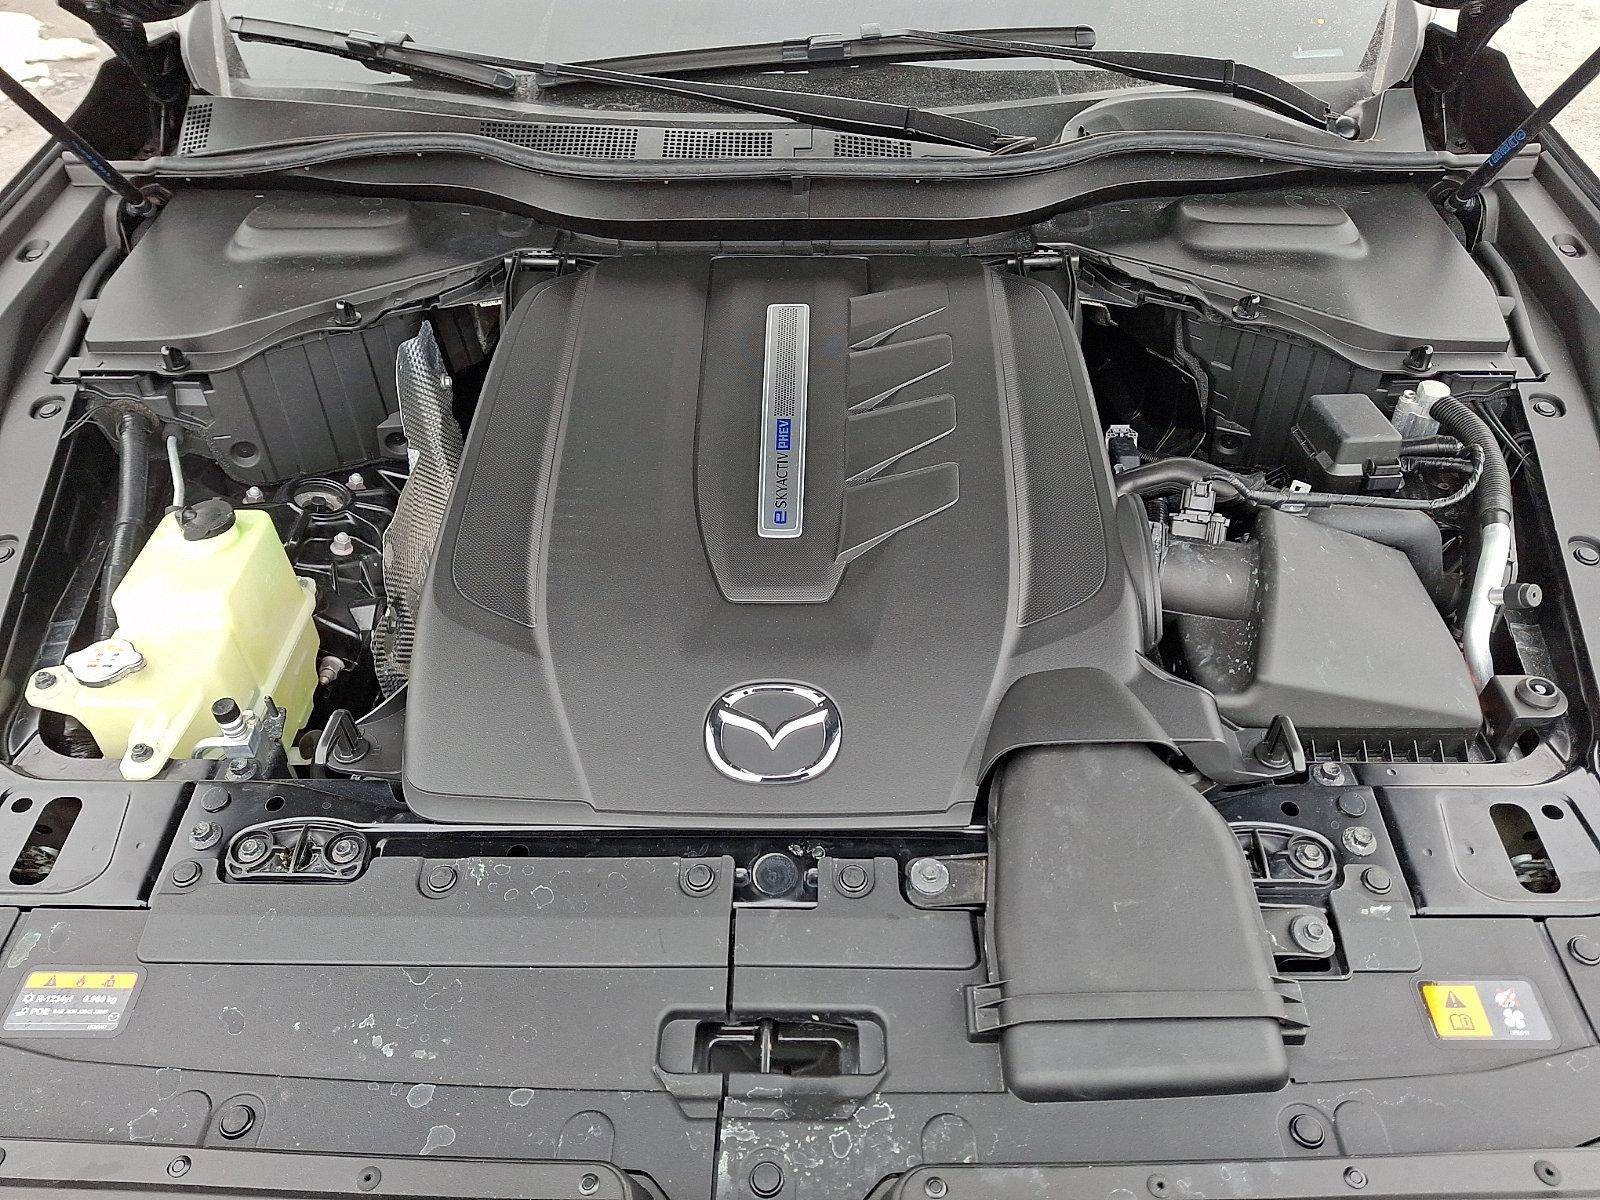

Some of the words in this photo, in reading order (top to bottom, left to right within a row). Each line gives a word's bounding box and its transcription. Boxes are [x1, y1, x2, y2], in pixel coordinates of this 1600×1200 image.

[777, 419, 790, 450] PHEV
[775, 452, 789, 509] SKYACTIV
[29, 1007, 51, 1016] POE
